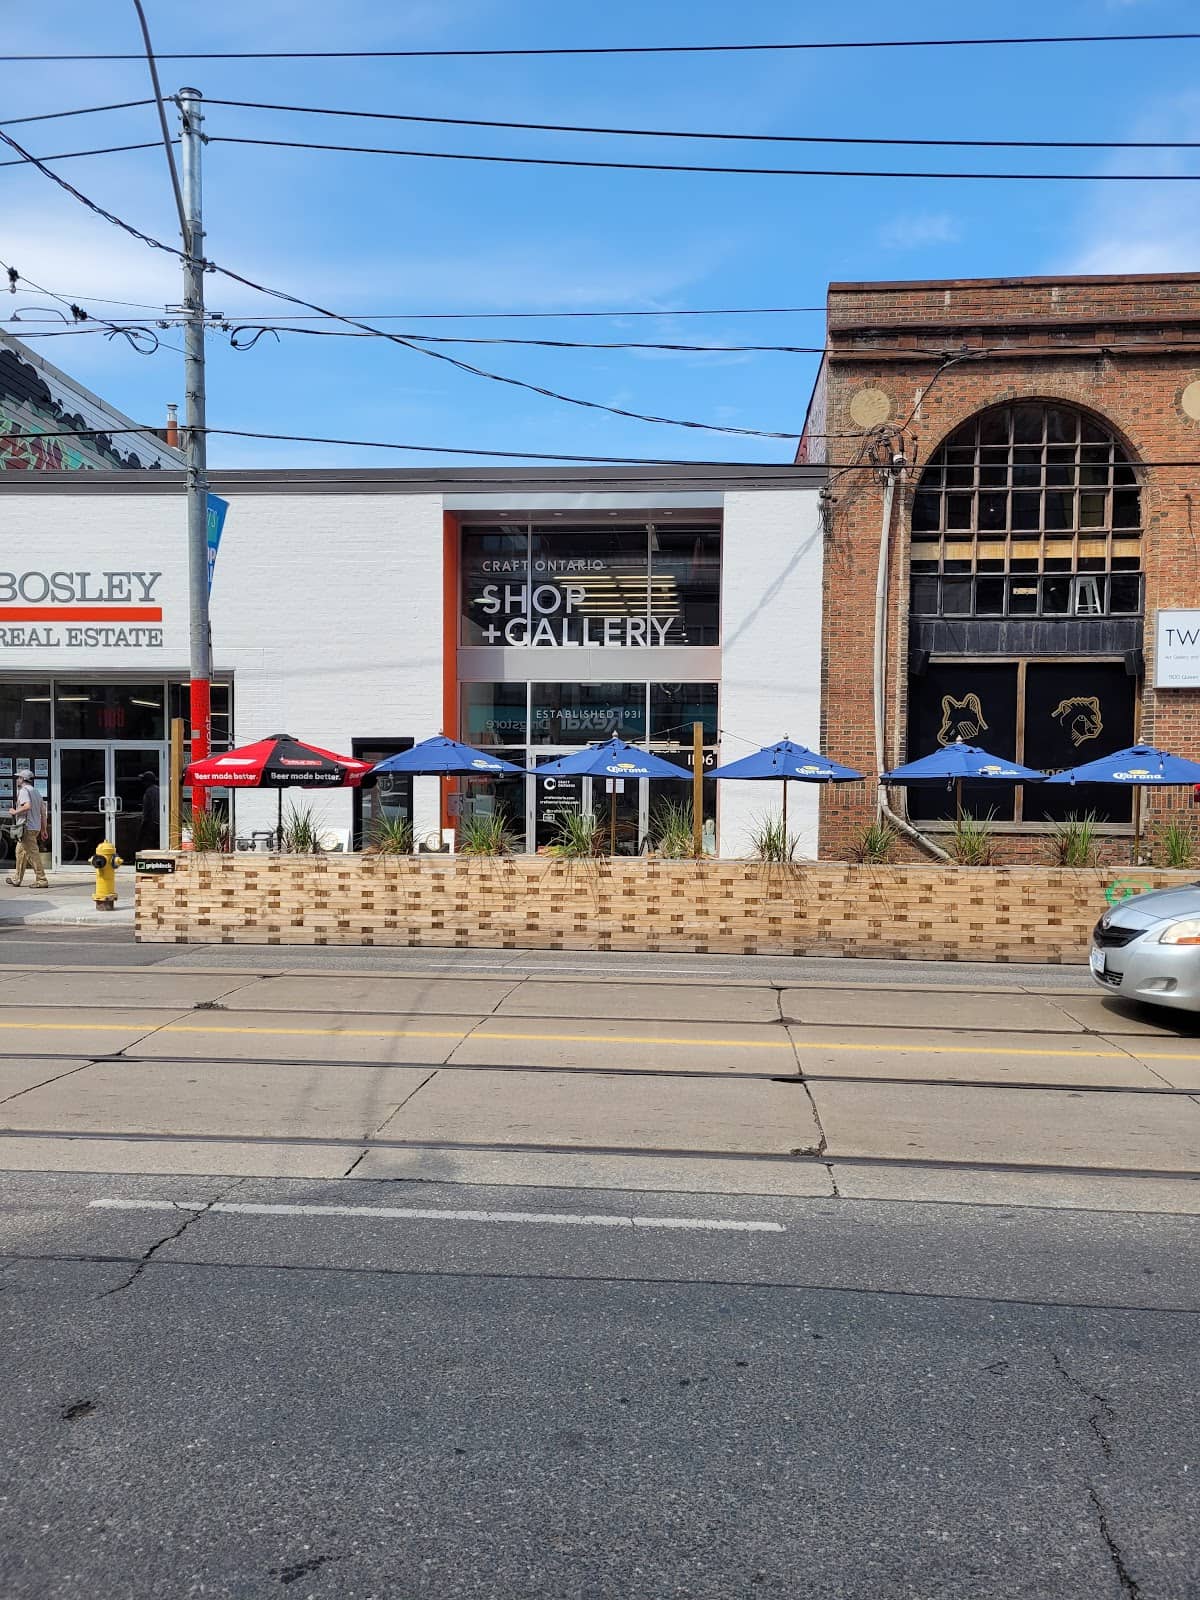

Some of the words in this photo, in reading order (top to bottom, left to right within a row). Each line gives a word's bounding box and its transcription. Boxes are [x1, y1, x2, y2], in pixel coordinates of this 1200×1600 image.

[482, 560, 528, 572] CRAFT
[535, 559, 604, 572] ONTARIO
[0, 571, 162, 603] BOSLEY
[482, 585, 586, 614] SHOP
[66, 628, 163, 647] ESTATE
[482, 617, 675, 647] +GALLERY
[536, 710, 614, 719] ESTABLISHED
[620, 710, 641, 719] 1931
[606, 764, 648, 773] Corona
[195, 772, 211, 780] Beer
[212, 772, 233, 780] made
[234, 772, 258, 780] better.
[271, 772, 289, 780] Beer
[291, 772, 313, 780] made
[315, 772, 341, 781] better.
[1113, 772, 1164, 780] Corona
